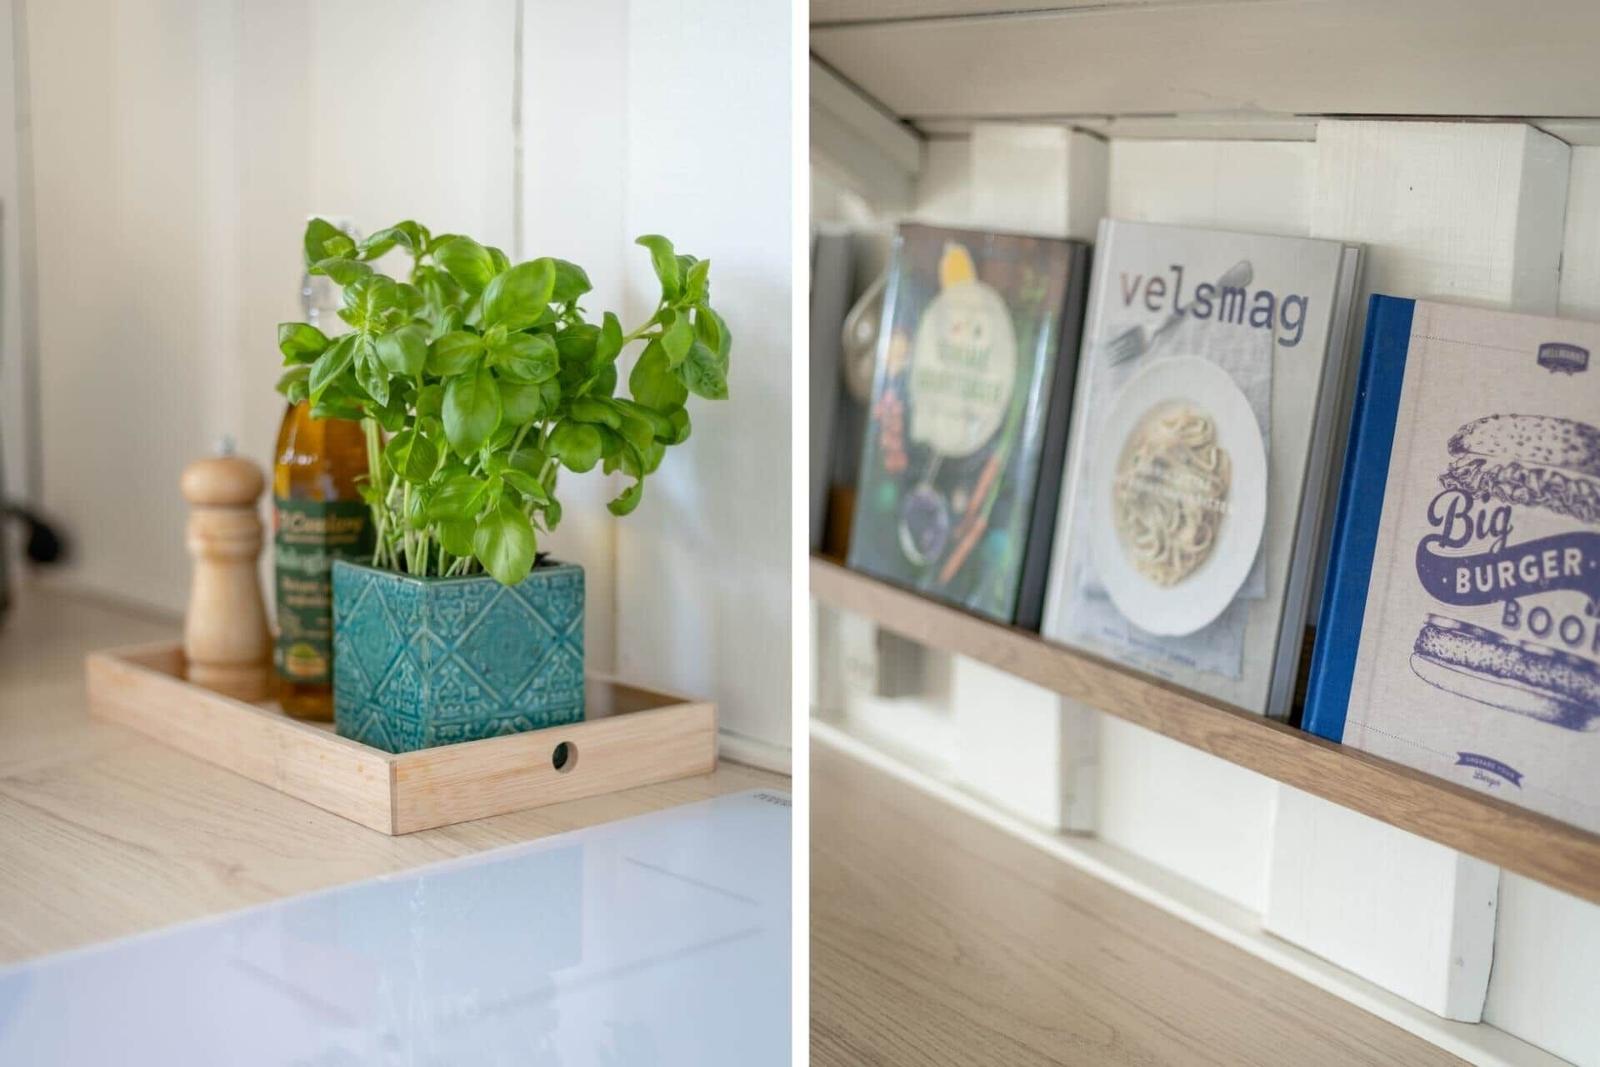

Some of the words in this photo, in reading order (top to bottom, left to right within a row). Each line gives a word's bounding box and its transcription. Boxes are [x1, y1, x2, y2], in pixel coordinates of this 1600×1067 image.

[1119, 264, 1309, 347] velsmag
[1427, 488, 1514, 554] Big
[1455, 548, 1583, 594] BURGER
